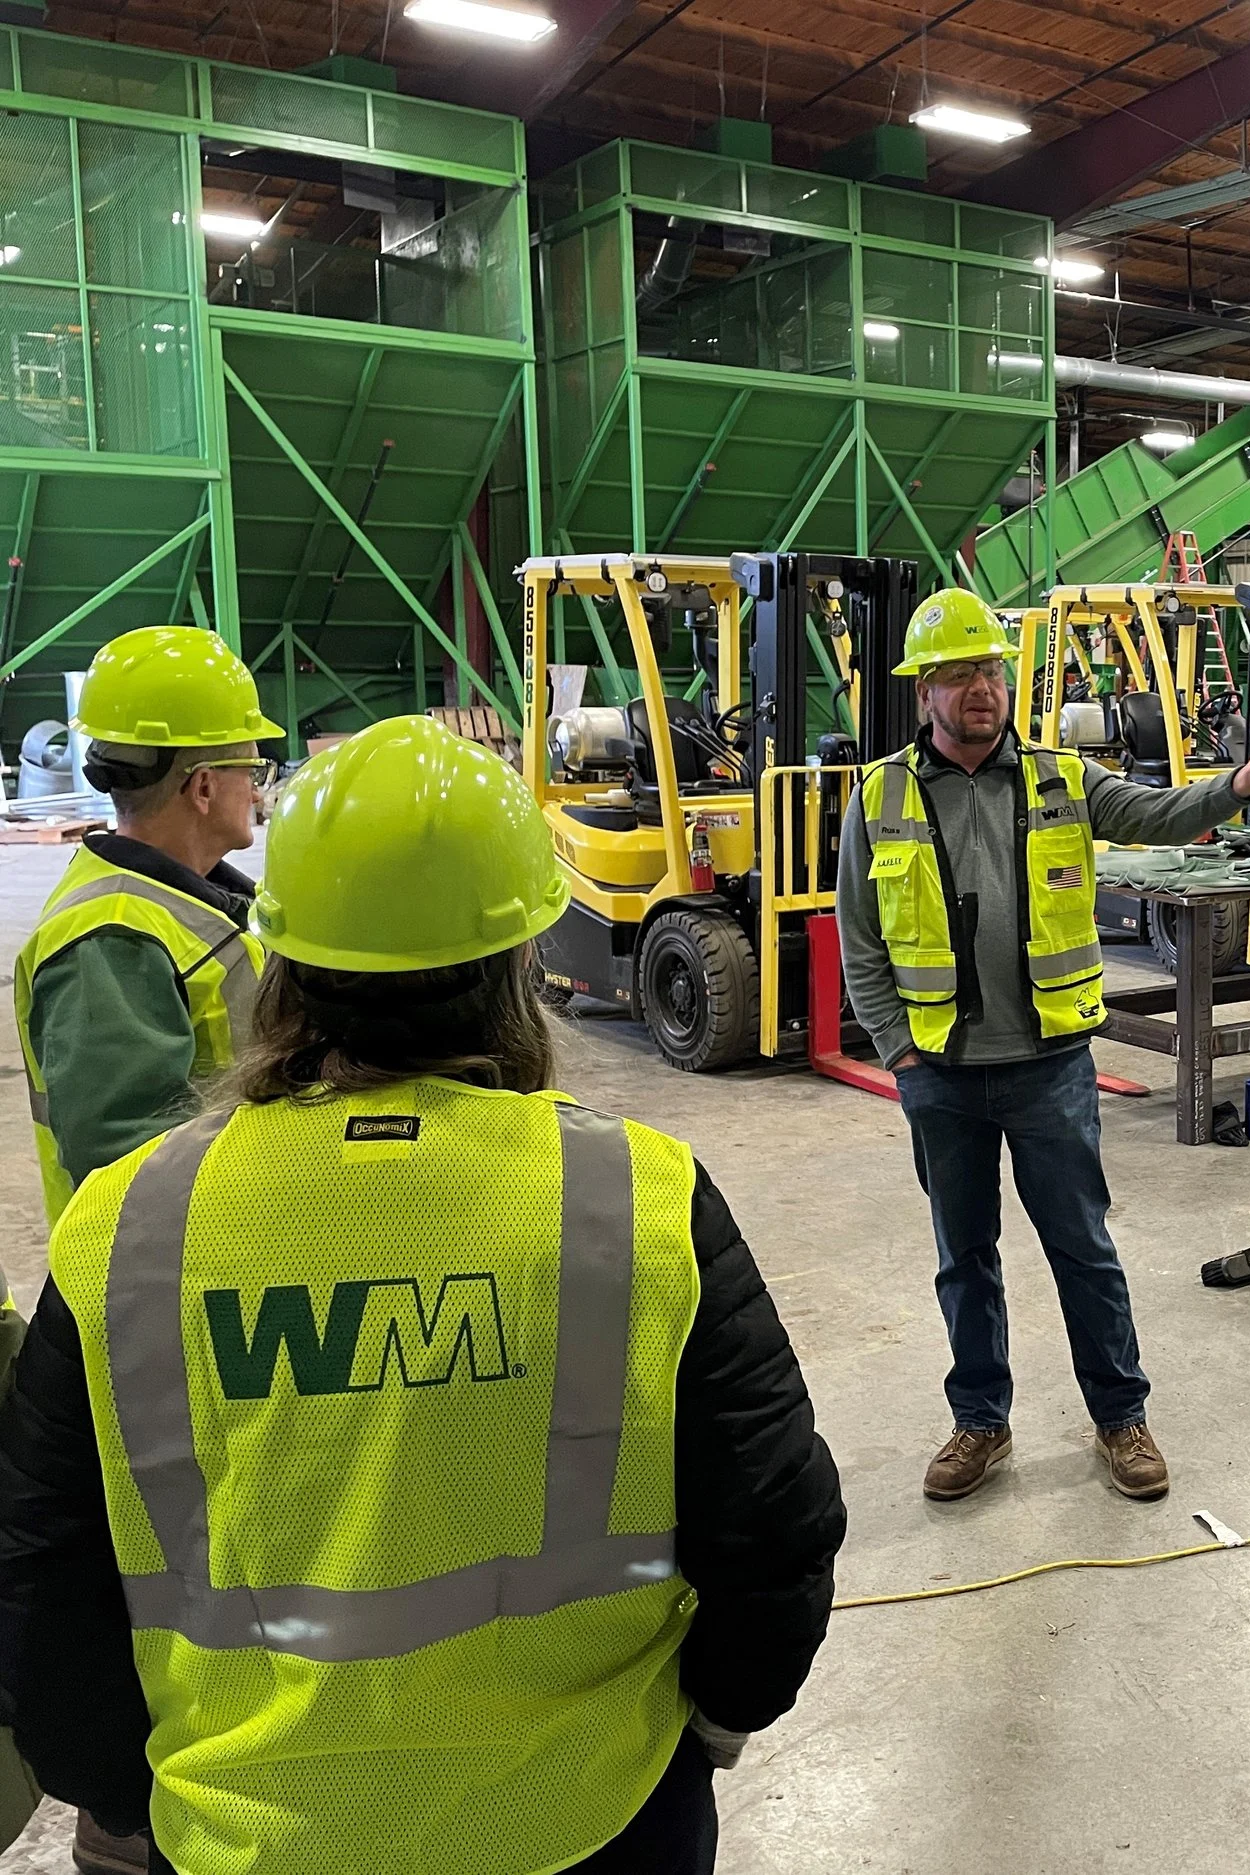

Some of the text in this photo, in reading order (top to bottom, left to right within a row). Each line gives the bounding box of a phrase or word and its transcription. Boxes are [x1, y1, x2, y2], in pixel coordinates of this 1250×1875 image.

[525, 586, 534, 728] 859881
[1045, 607, 1058, 712] 859880
[1041, 805, 1074, 820] WM
